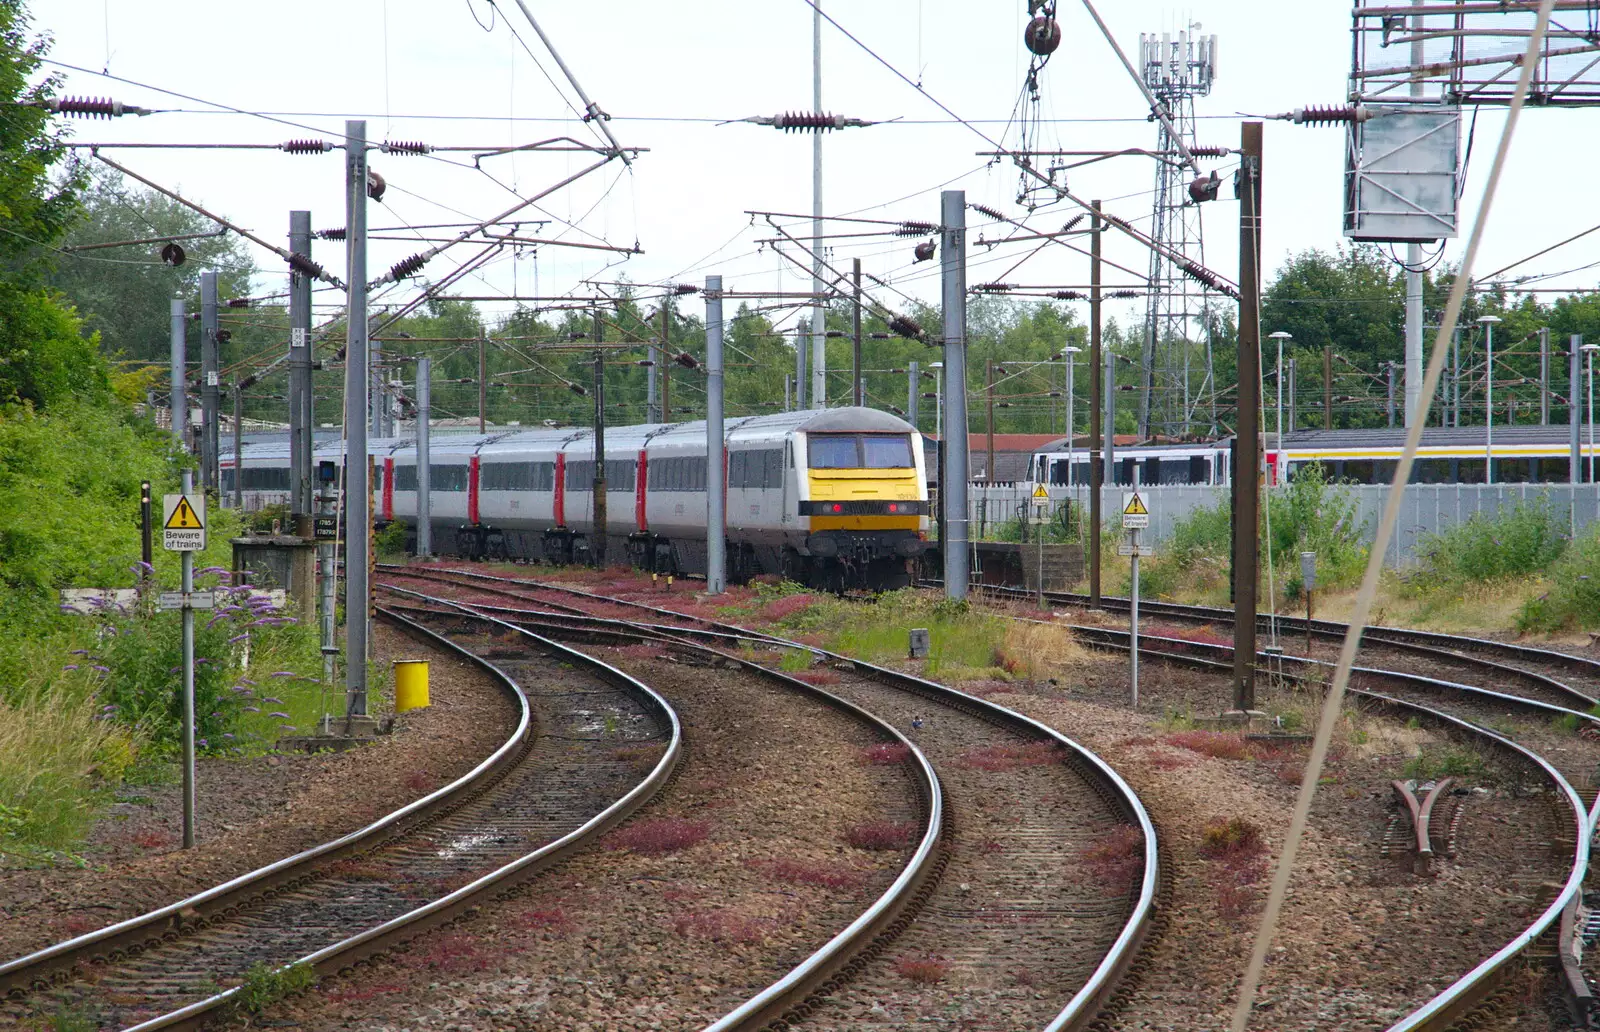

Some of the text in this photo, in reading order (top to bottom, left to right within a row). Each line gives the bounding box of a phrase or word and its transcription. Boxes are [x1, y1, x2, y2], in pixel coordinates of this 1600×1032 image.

[165, 531, 200, 539] Beware
[165, 540, 202, 548] of trains
